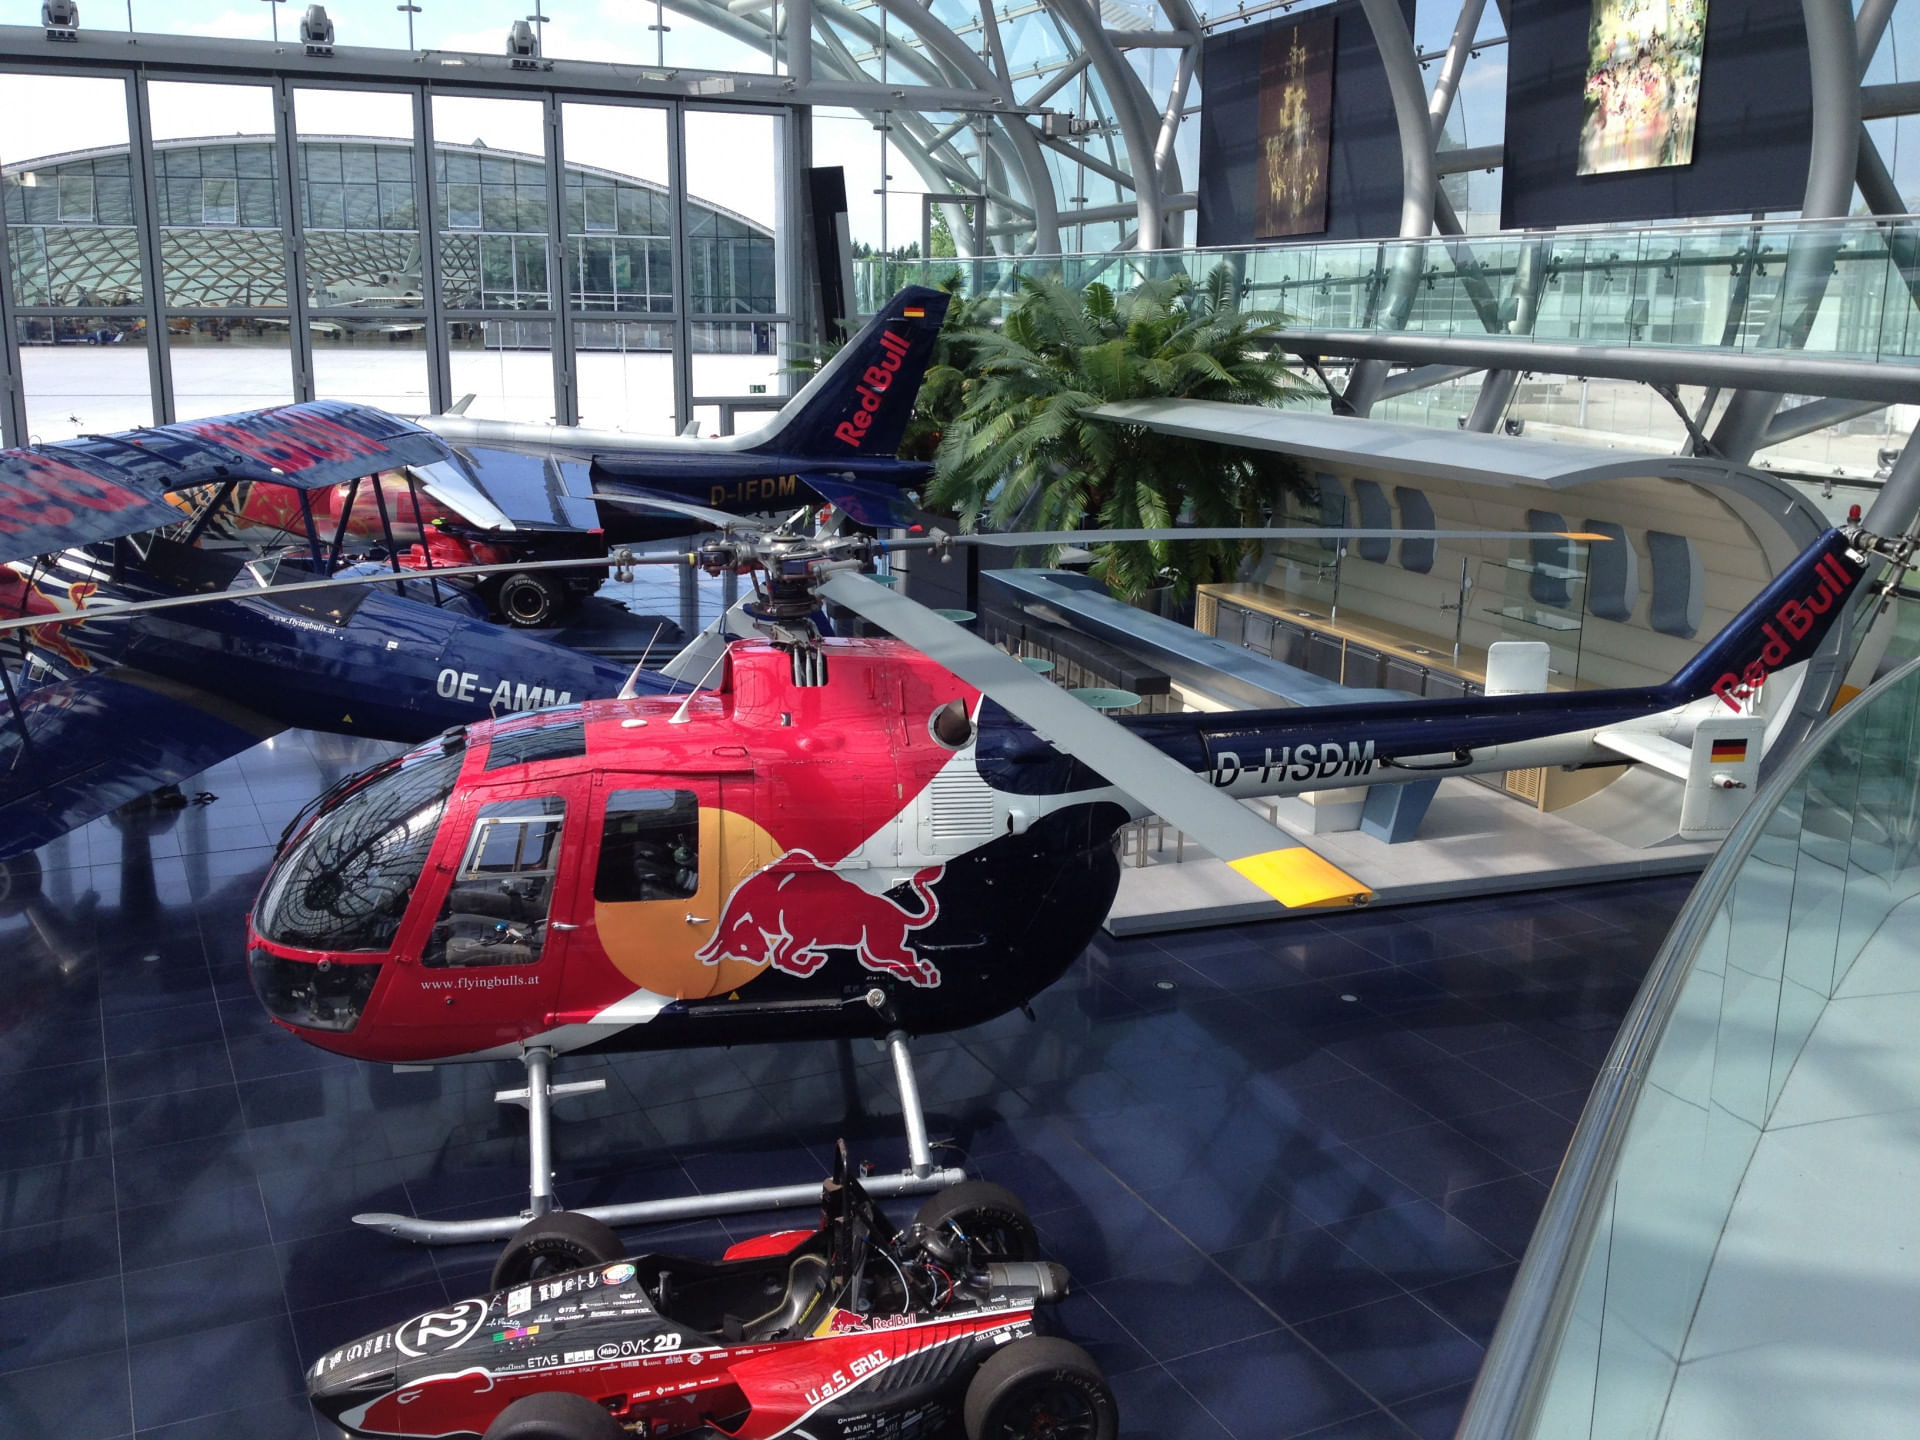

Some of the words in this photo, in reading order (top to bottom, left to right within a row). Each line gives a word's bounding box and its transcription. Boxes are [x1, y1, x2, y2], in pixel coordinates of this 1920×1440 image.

[834, 385, 883, 447] Red
[863, 330, 911, 393] Bull
[0, 450, 149, 533] ed
[191, 408, 389, 474] Bull
[710, 474, 796, 506] D-IFDM
[268, 614, 336, 635] www.flyingbulls.at
[1711, 623, 1791, 713] Red
[1776, 552, 1852, 640] Bull
[437, 668, 571, 711] OE-AMM
[1214, 740, 1374, 787] D-HSDM
[421, 975, 539, 990] www.flyingbulls.at
[872, 1315, 894, 1329] Red
[895, 1313, 917, 1327] Bull
[653, 1333, 682, 1352] 2D
[528, 1355, 559, 1368] ETAS
[849, 1349, 888, 1377] GRAZ
[852, 1422, 872, 1433] Altair
